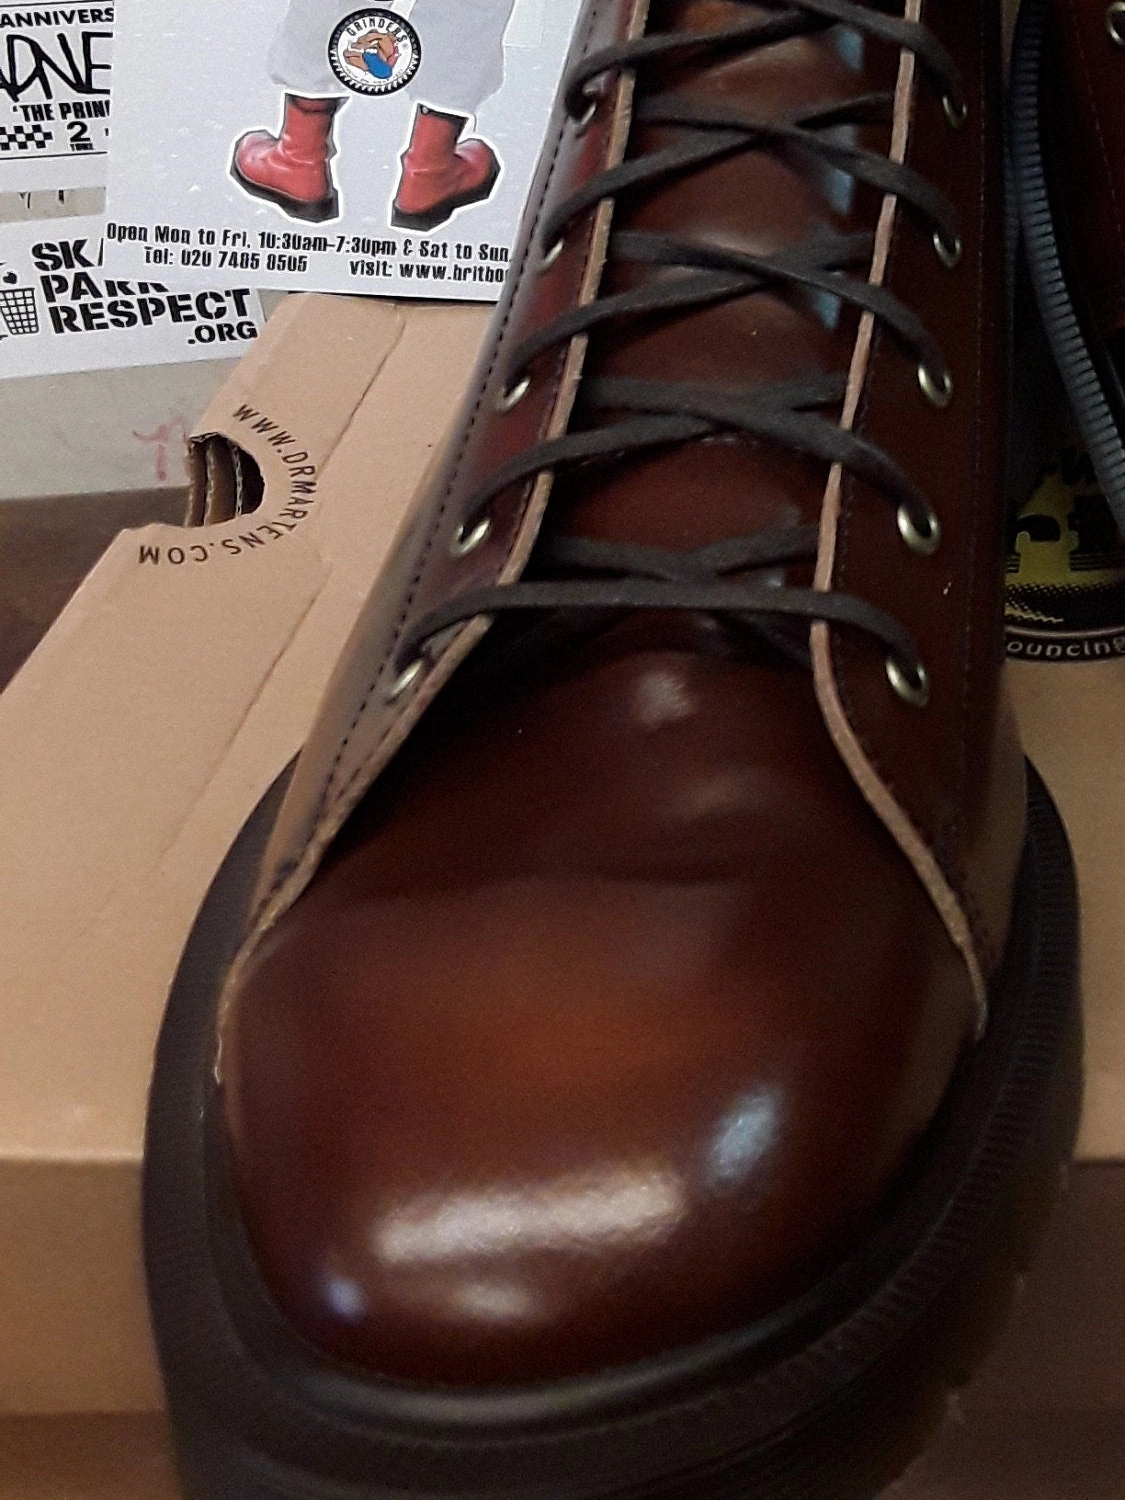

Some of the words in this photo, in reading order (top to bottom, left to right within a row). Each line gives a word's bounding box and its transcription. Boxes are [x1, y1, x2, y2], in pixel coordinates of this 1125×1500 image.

[32, 238, 104, 272] SK
[107, 222, 148, 243] Open
[155, 225, 190, 245] Mon
[198, 228, 215, 246] to
[419, 240, 448, 259] Sat
[455, 242, 472, 260] to
[144, 246, 173, 265] Tel:
[181, 249, 211, 267] 020
[49, 288, 250, 334] RESPECT
[188, 321, 258, 344] .ORG
